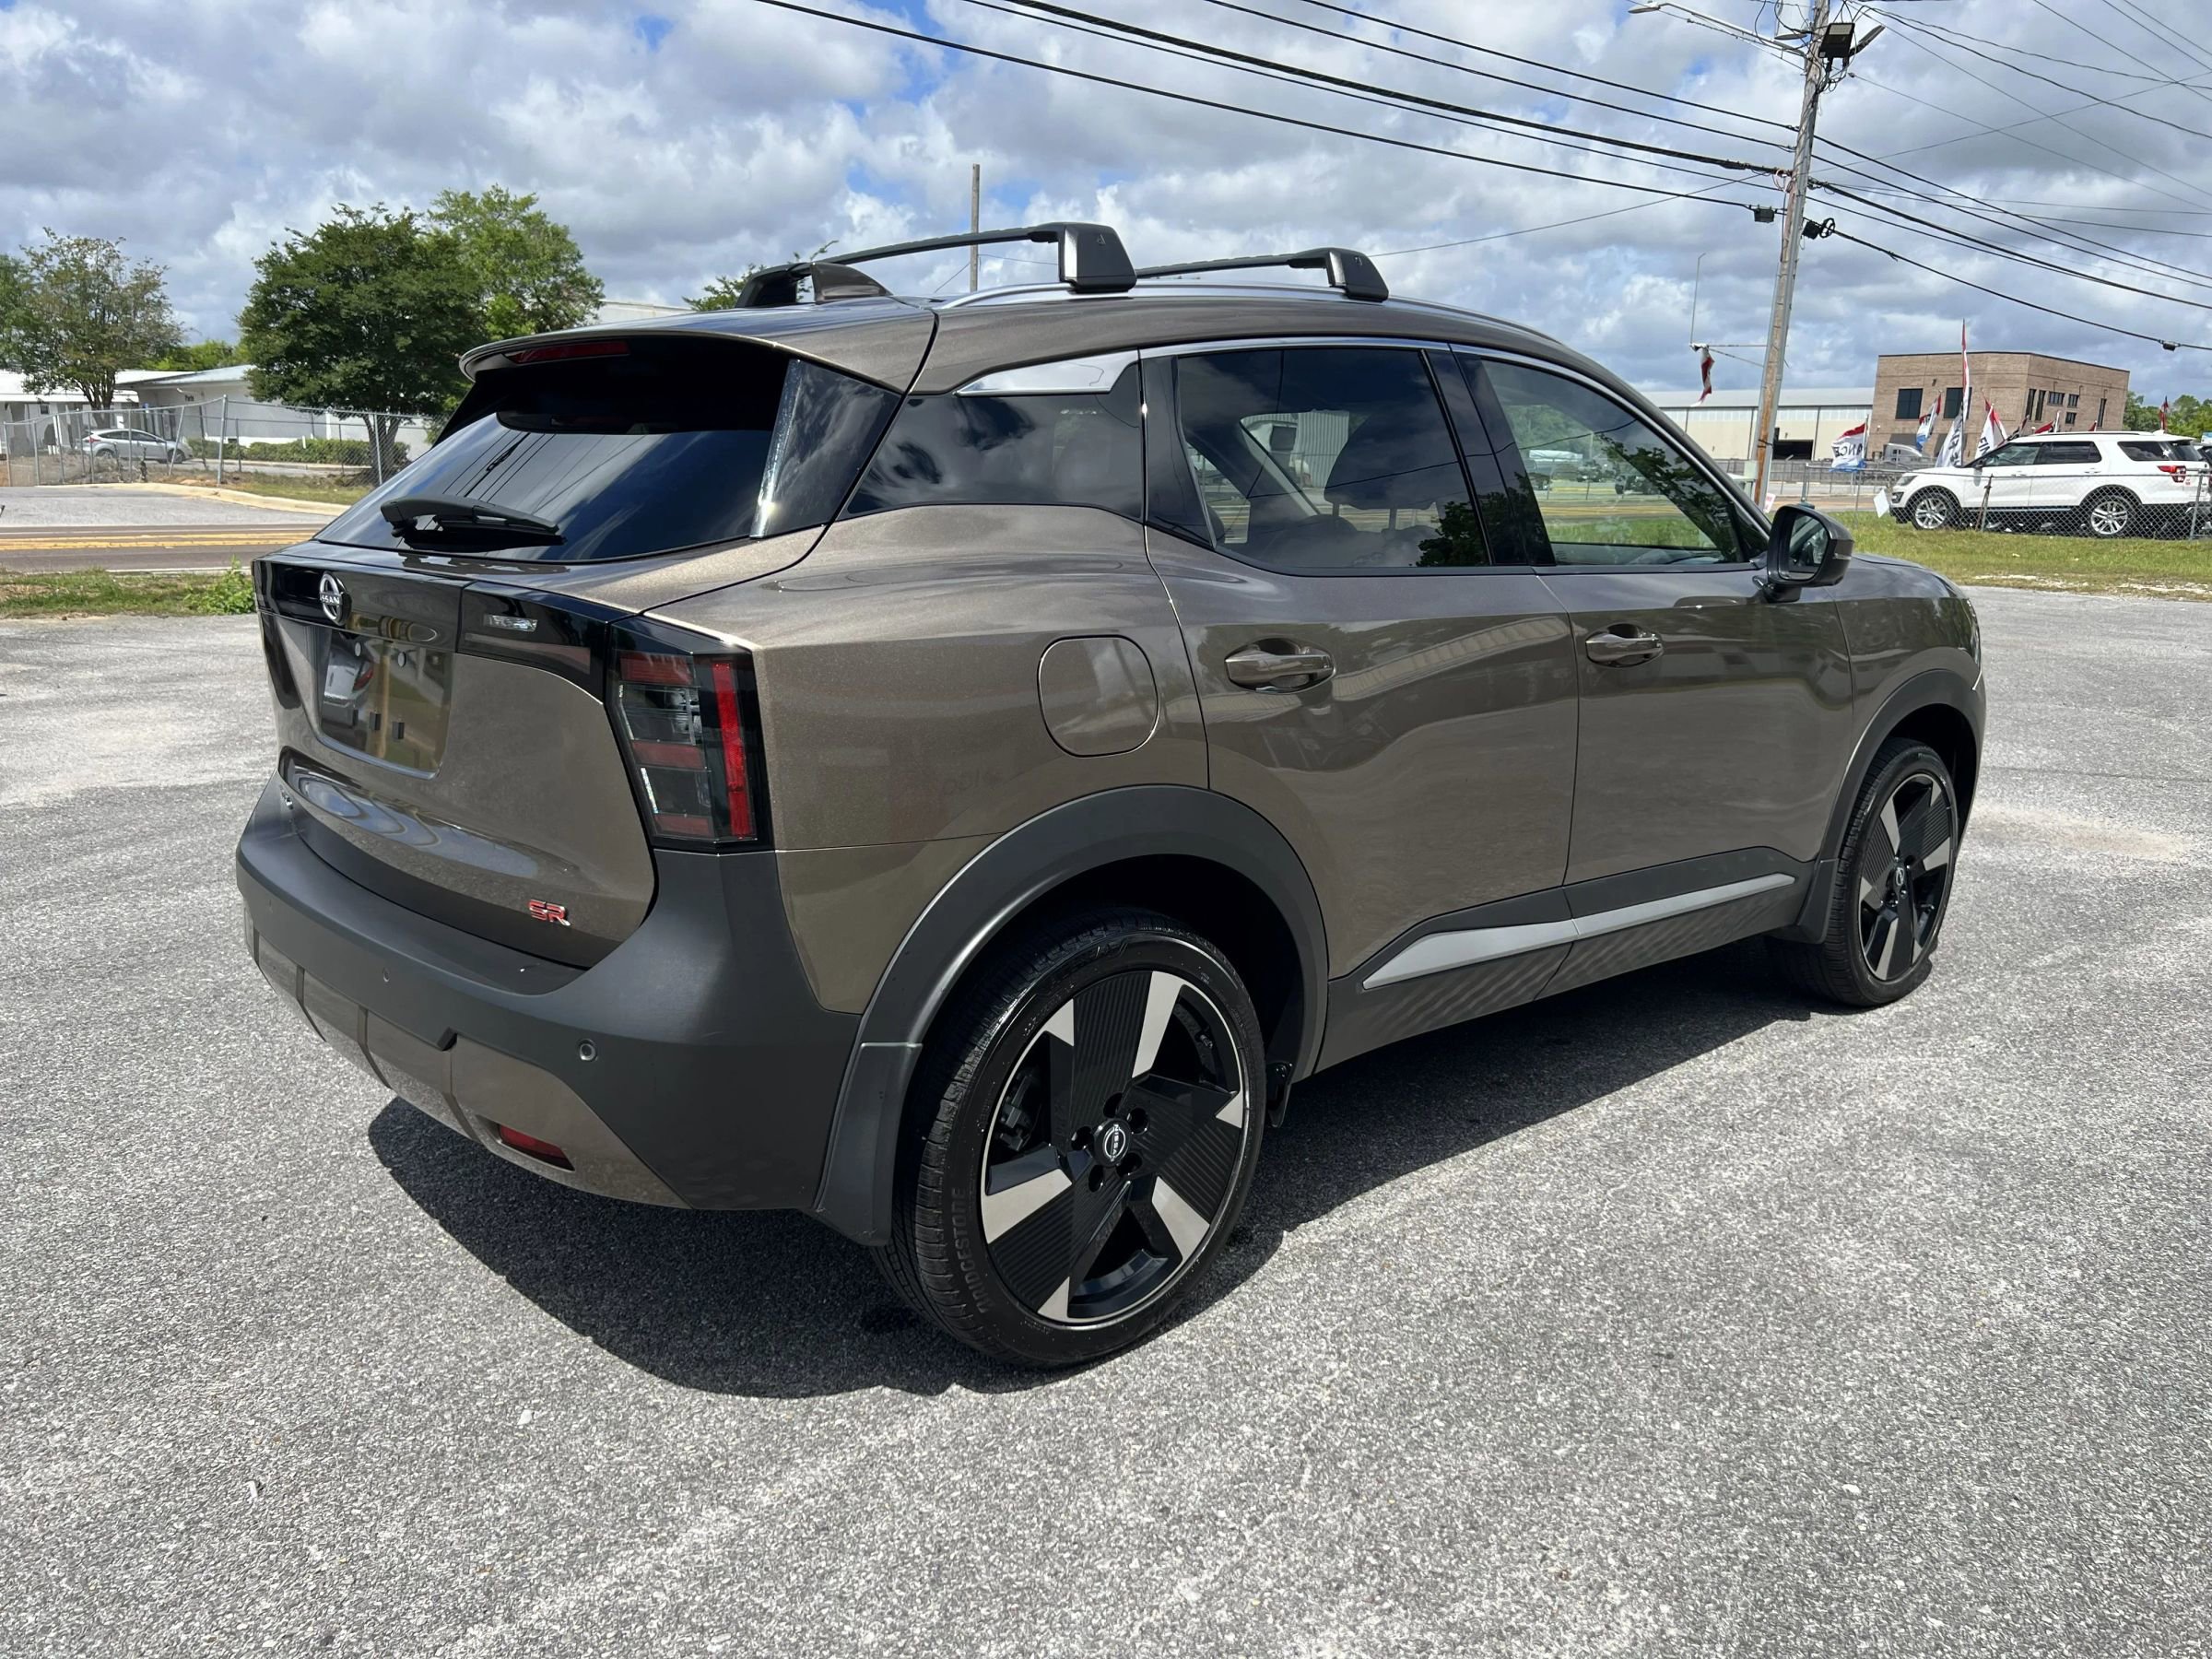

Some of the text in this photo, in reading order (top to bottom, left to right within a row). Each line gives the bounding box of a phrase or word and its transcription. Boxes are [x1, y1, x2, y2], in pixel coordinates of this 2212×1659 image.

[528, 899, 571, 926] SR
[1111, 1124, 1120, 1162] NISSAN
[950, 1187, 994, 1313] BRIDGESTONE
